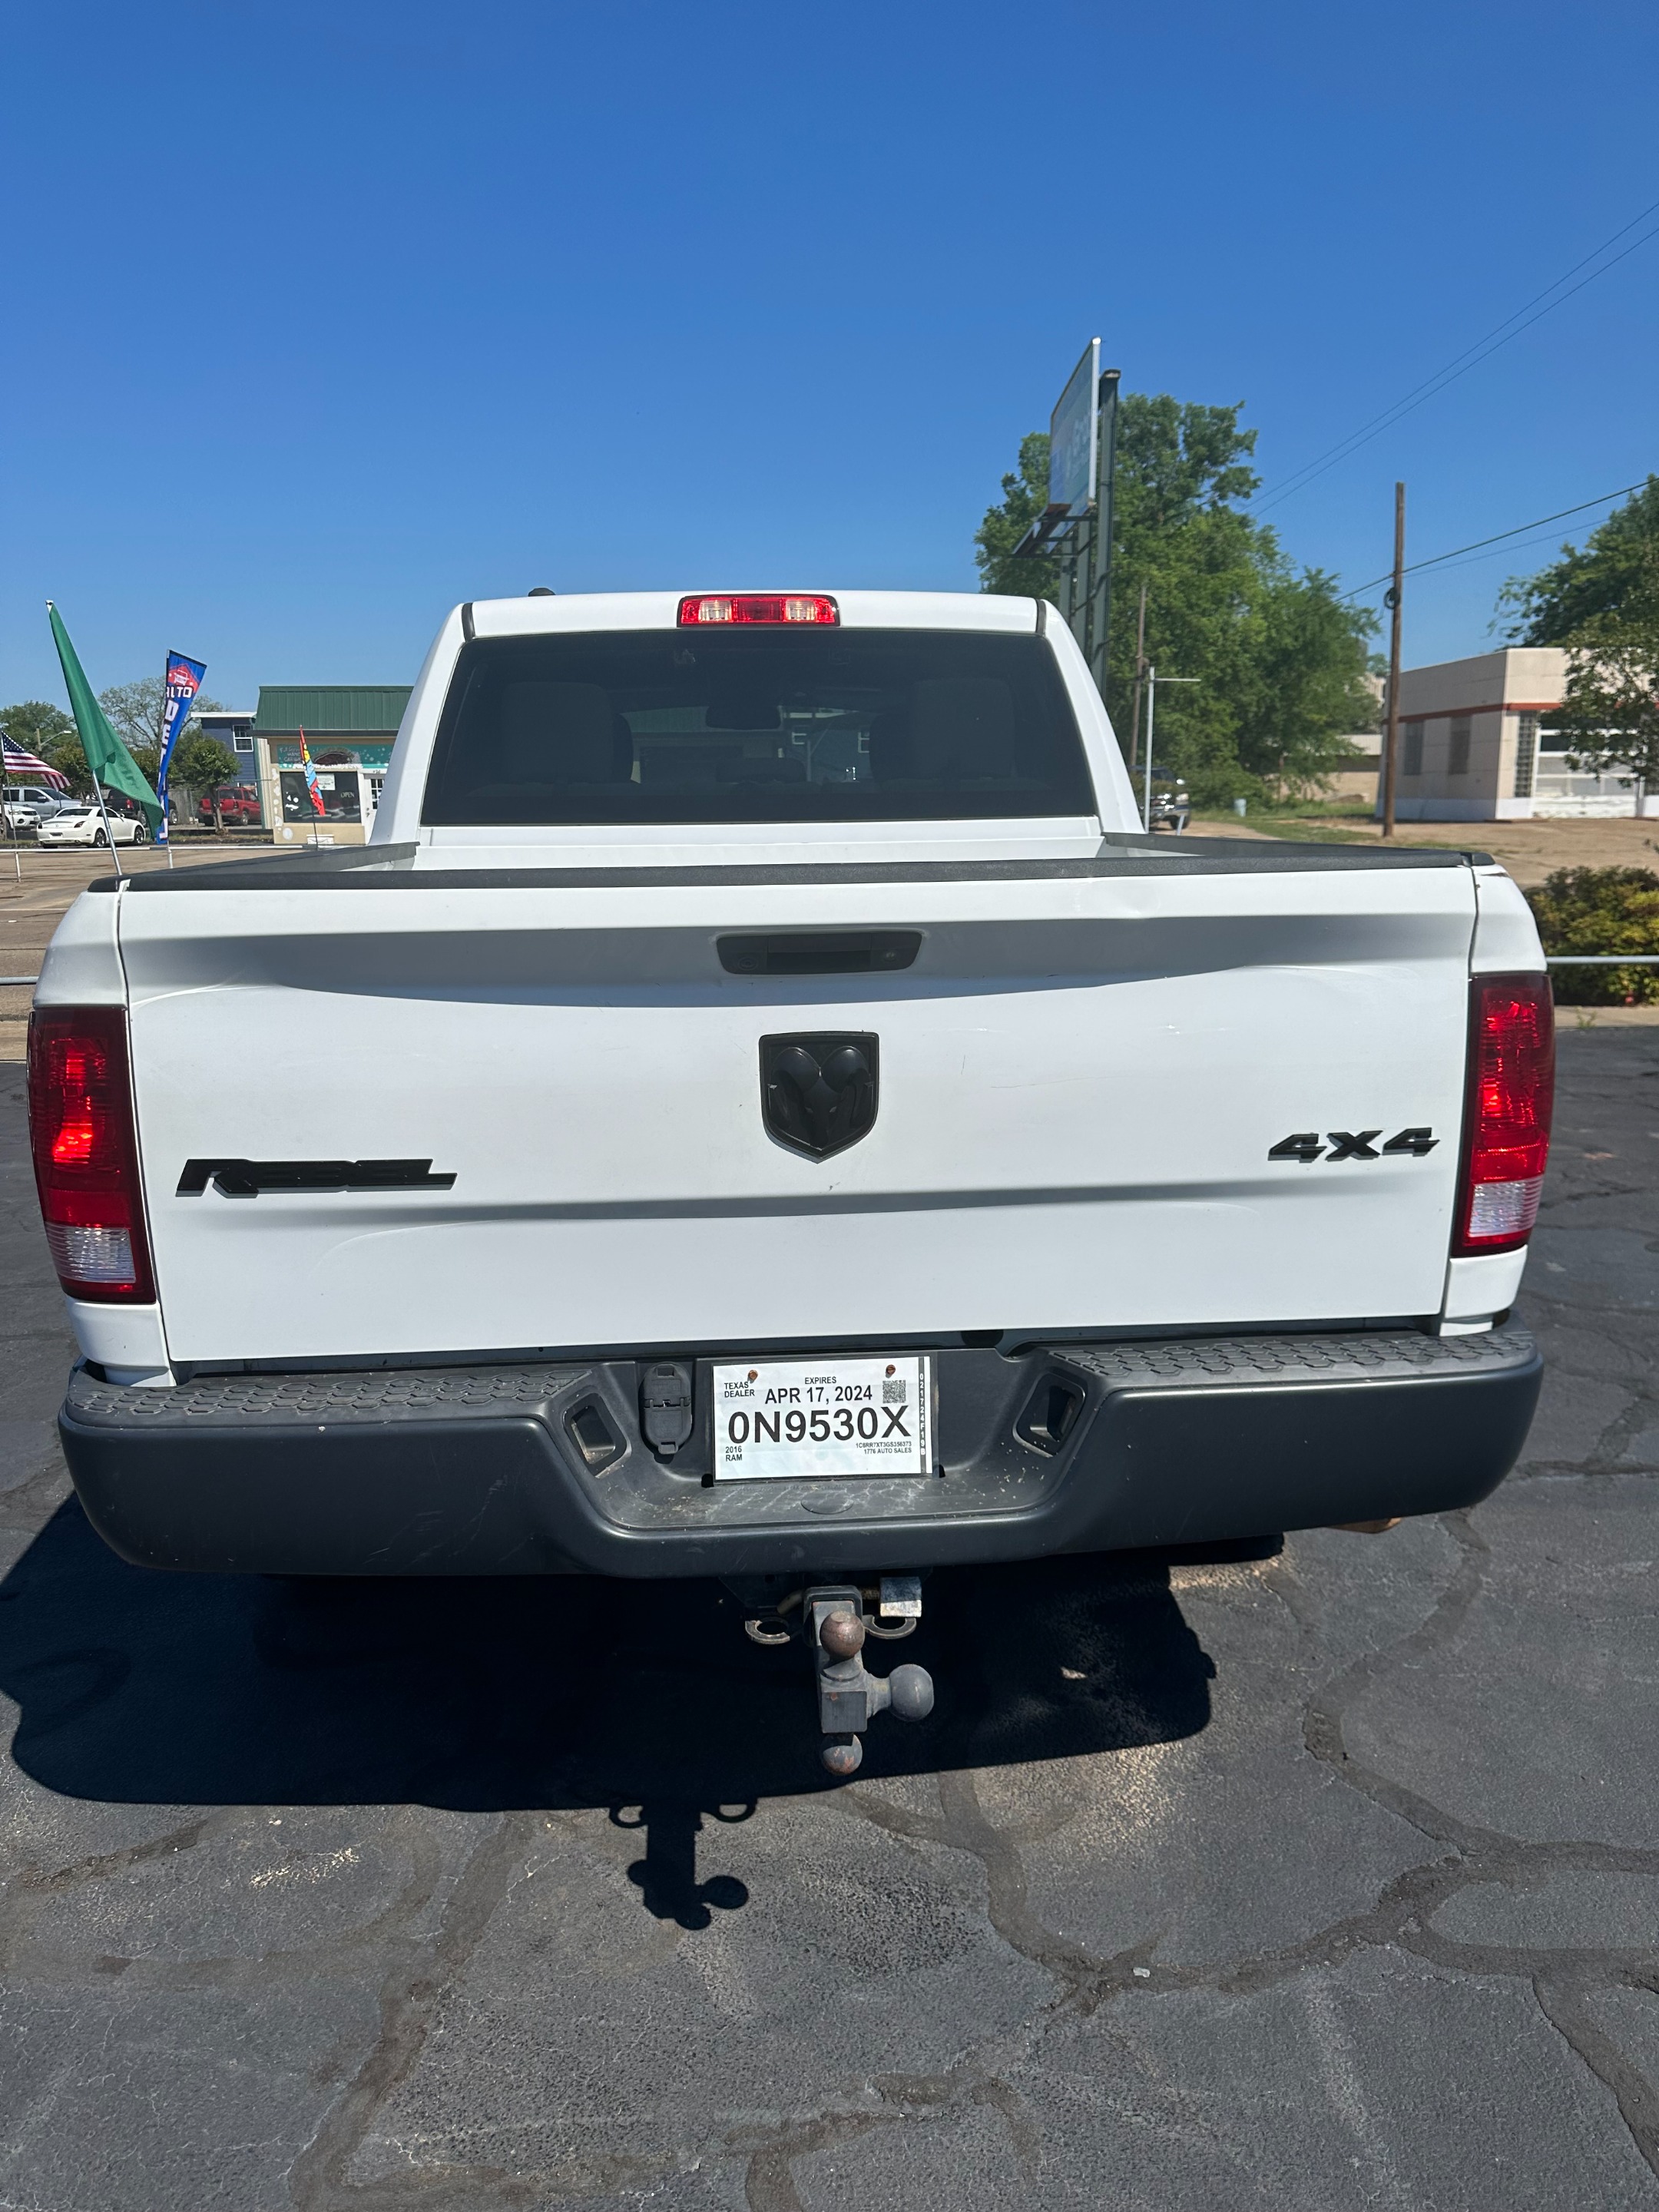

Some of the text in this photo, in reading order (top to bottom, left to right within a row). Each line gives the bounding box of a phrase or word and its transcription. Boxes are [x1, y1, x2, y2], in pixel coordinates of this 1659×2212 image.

[1267, 1127, 1440, 1164] 4X4
[175, 1158, 458, 1199] REBEL
[724, 1381, 749, 1390] TEXAS
[804, 1376, 836, 1385] EXPIRES
[724, 1389, 755, 1398] DEALER
[764, 1385, 873, 1405] APR 17, 2024
[728, 1405, 912, 1444] 0N9530X
[725, 1454, 742, 1462] RAM
